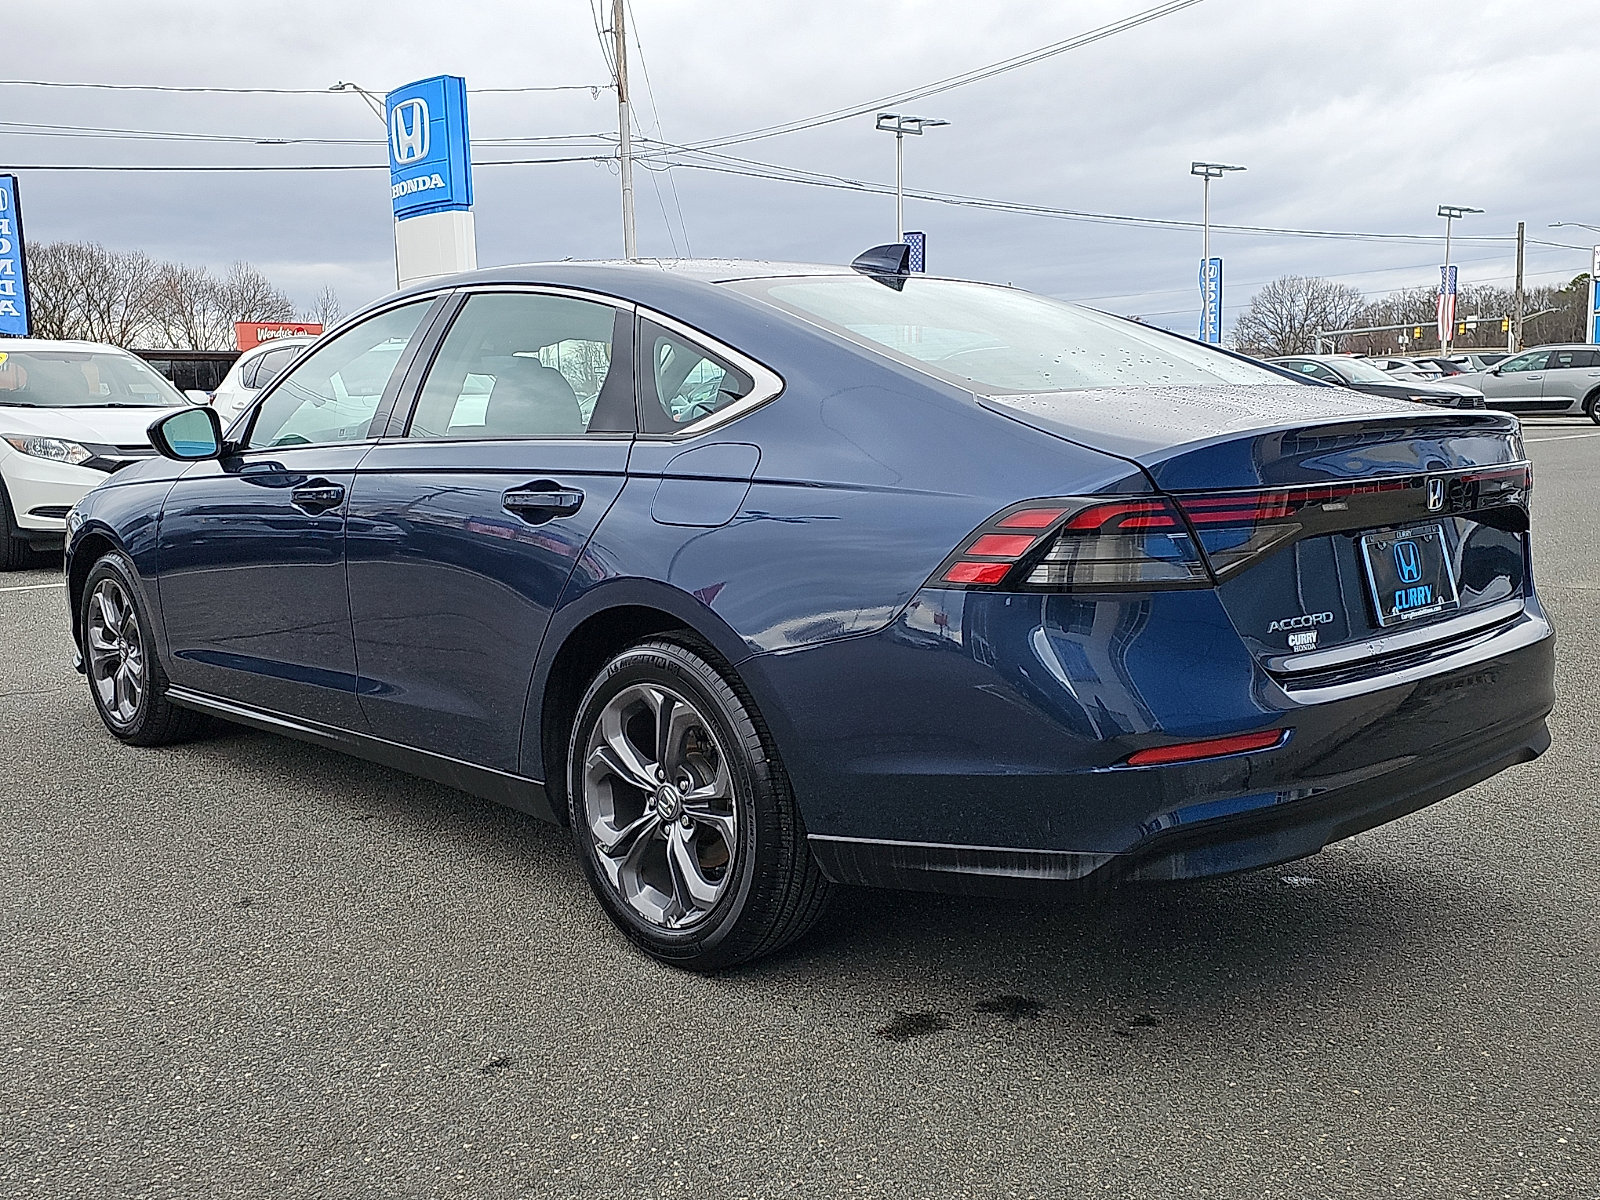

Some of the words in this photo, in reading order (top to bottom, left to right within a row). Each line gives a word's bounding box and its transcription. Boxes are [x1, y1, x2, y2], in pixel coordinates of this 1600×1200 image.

[391, 173, 446, 199] HONDA
[257, 326, 293, 341] Wendy's
[1395, 584, 1433, 611] CURRY
[1266, 611, 1334, 634] ACCORD
[1288, 632, 1317, 647] CURRY
[1293, 643, 1317, 653] HONDA
